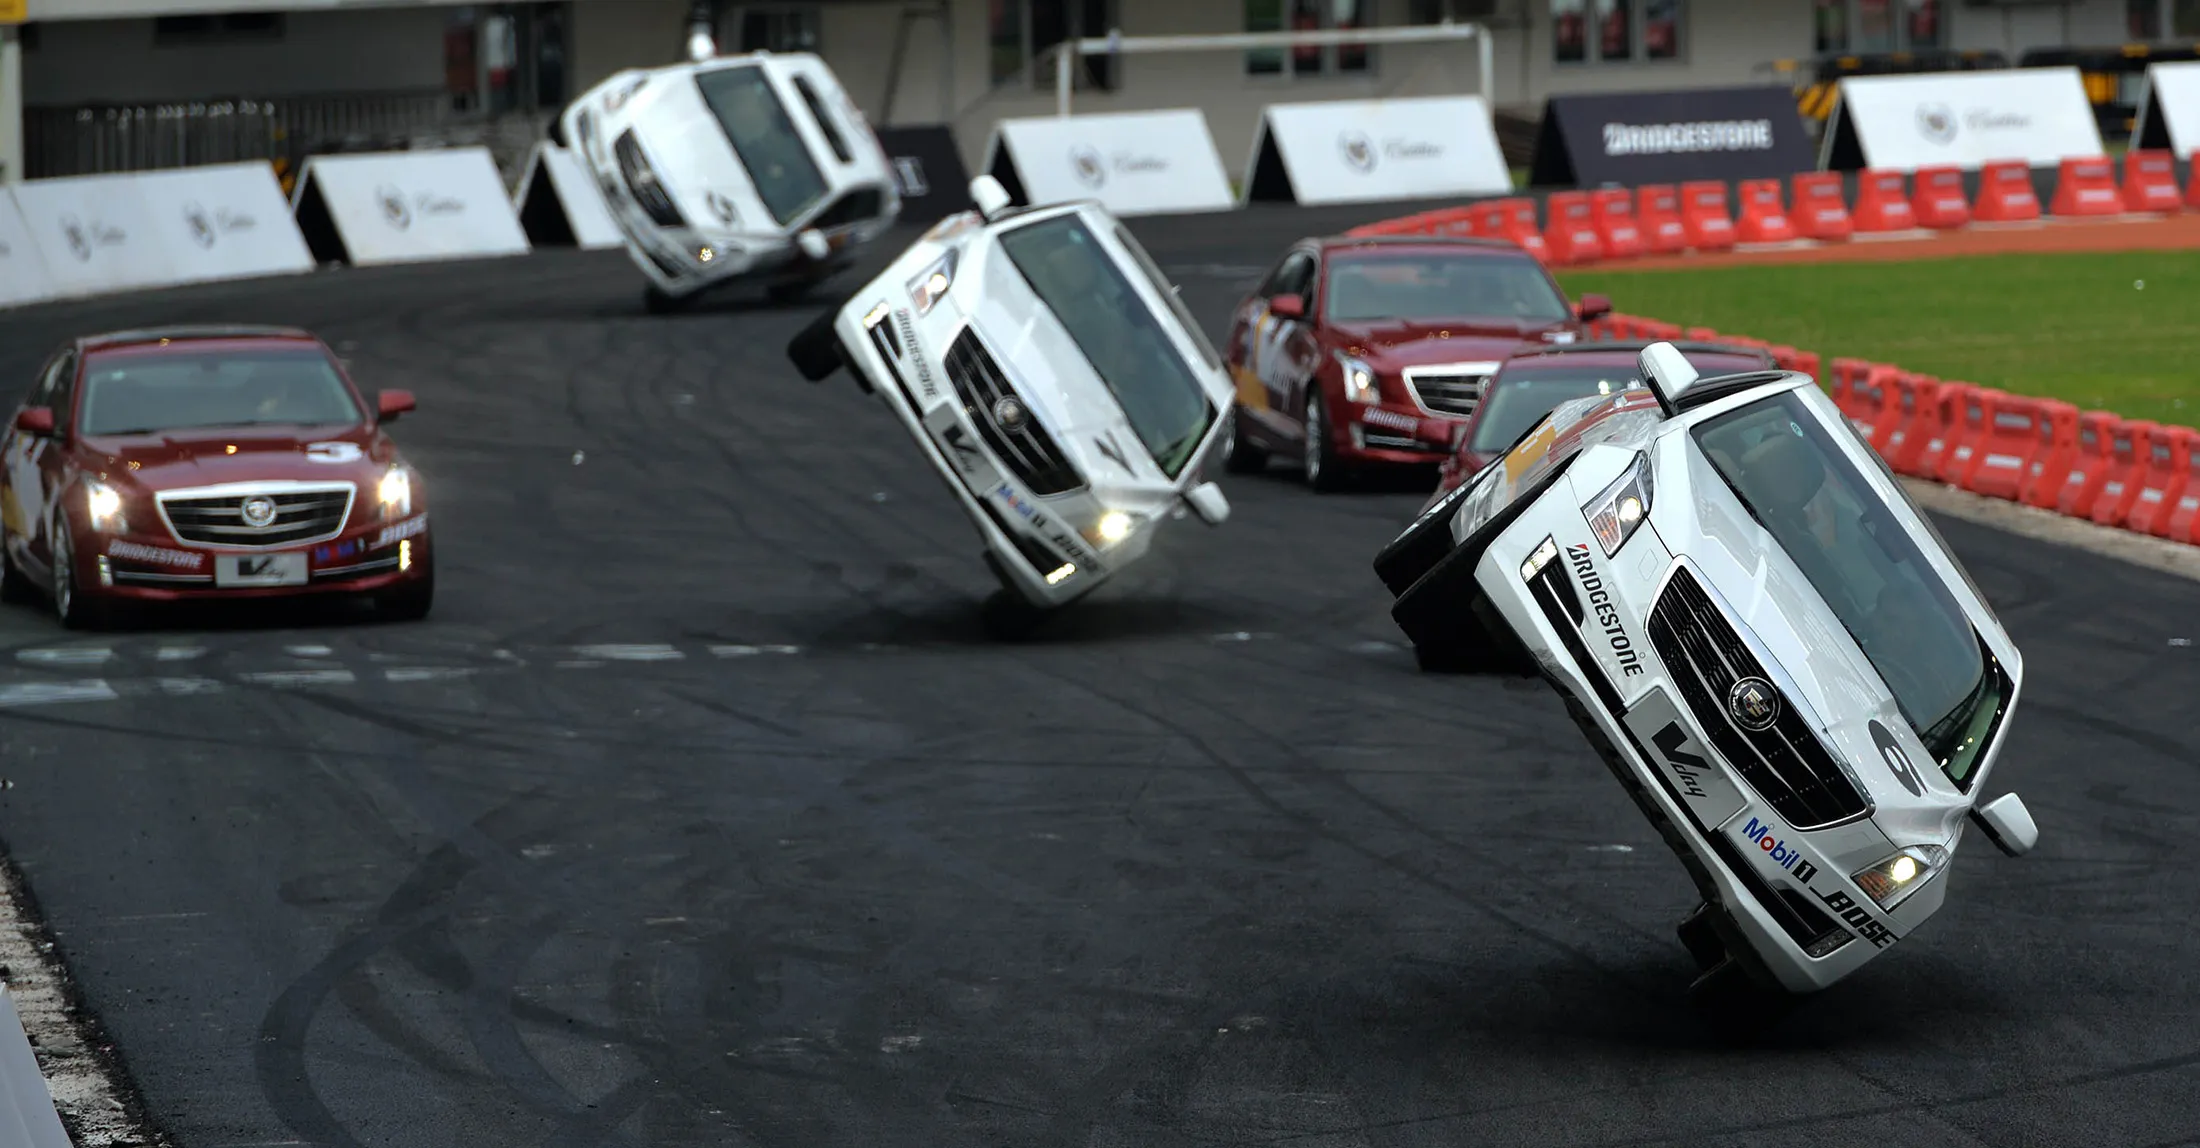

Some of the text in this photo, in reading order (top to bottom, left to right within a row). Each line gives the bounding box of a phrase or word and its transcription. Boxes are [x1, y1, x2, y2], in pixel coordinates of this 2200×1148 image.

[1603, 121, 1769, 155] BRIDGESTONE
[306, 441, 363, 464] 3
[1566, 543, 1644, 677] BRIDGESTONE
[1868, 719, 1929, 798] 6
[1742, 816, 1818, 884] Mobil 1
[1808, 886, 1900, 949] BOSE
